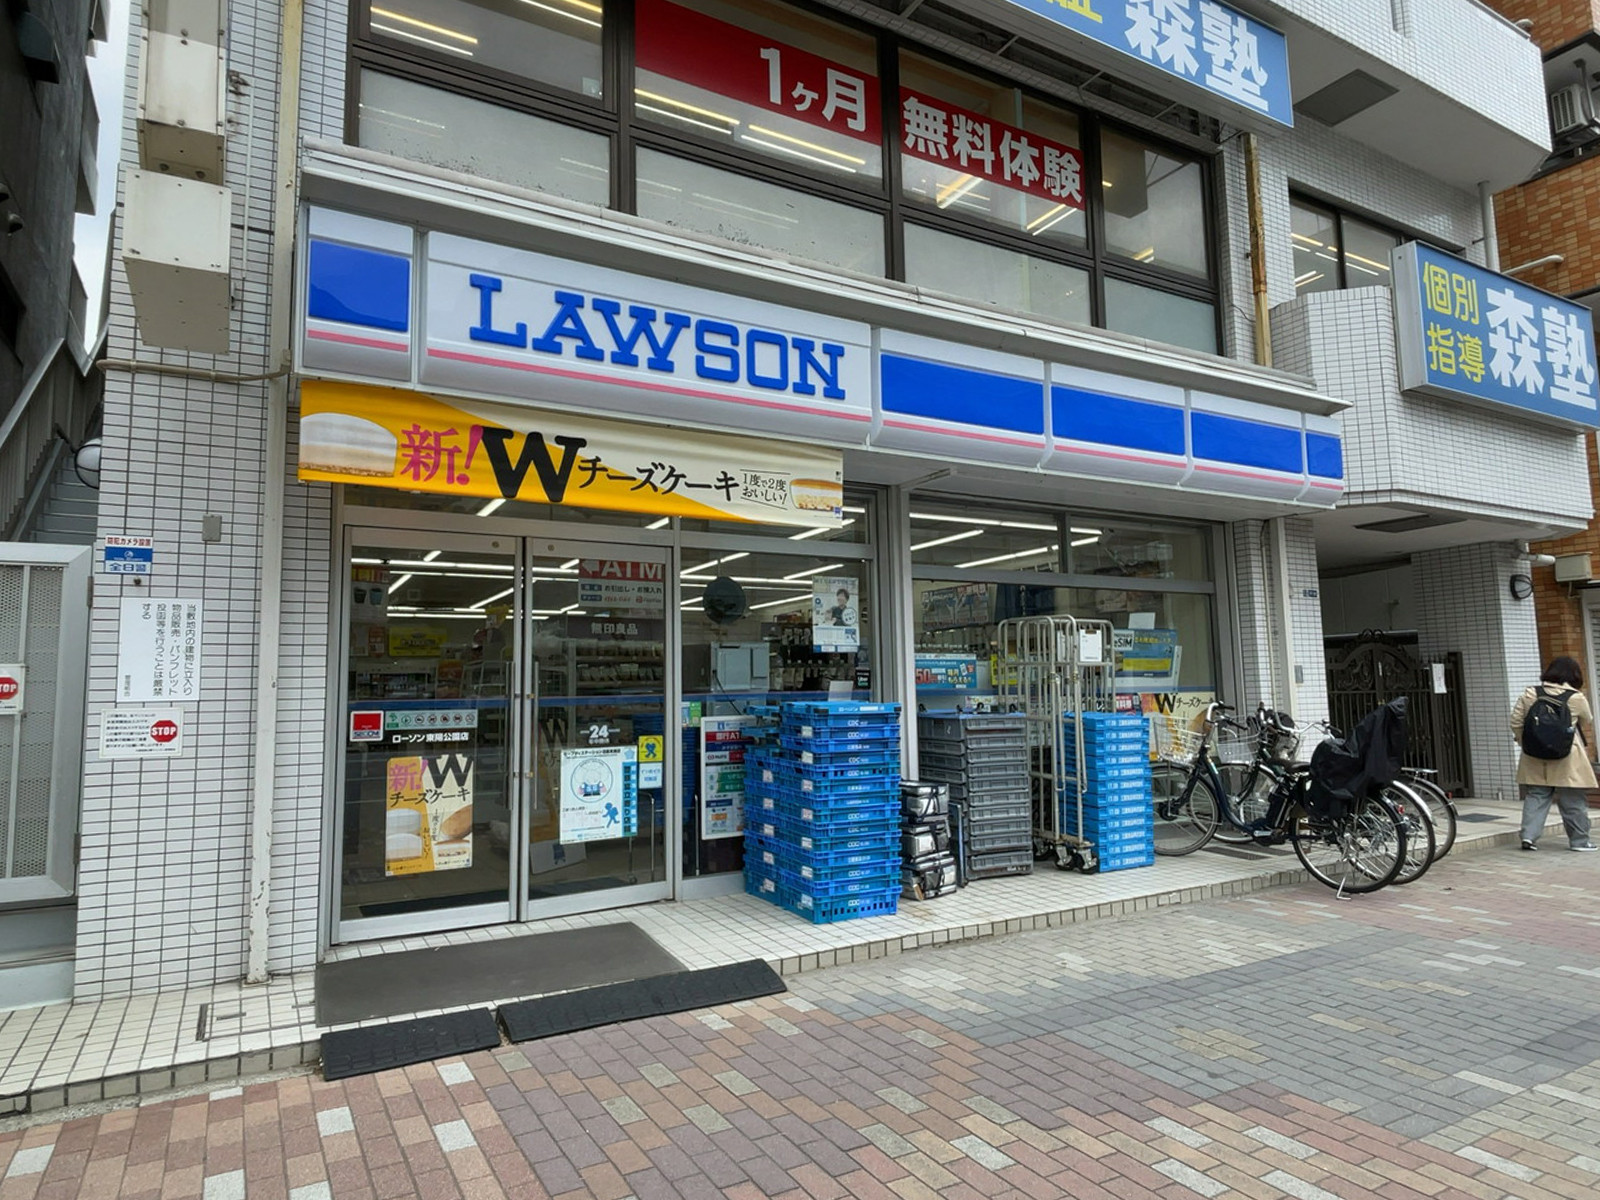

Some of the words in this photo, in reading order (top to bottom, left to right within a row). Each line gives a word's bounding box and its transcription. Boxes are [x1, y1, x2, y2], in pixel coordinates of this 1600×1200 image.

[1124, 0, 1269, 112] 森塾
[759, 47, 866, 133] 1ヶ月
[902, 95, 1083, 203] 無料体験
[1422, 261, 1480, 325] 個別
[469, 273, 846, 400] LAWSON
[1427, 321, 1486, 383] 指導
[1485, 287, 1597, 410] 森塾
[743, 473, 787, 493] 1度で2度
[742, 486, 788, 505] おいしい!
[600, 560, 663, 580] ATM
[0, 683, 17, 693] TOP
[151, 726, 177, 736] STOP
[589, 725, 610, 739] 24
[389, 787, 471, 808] チーズケーキ
